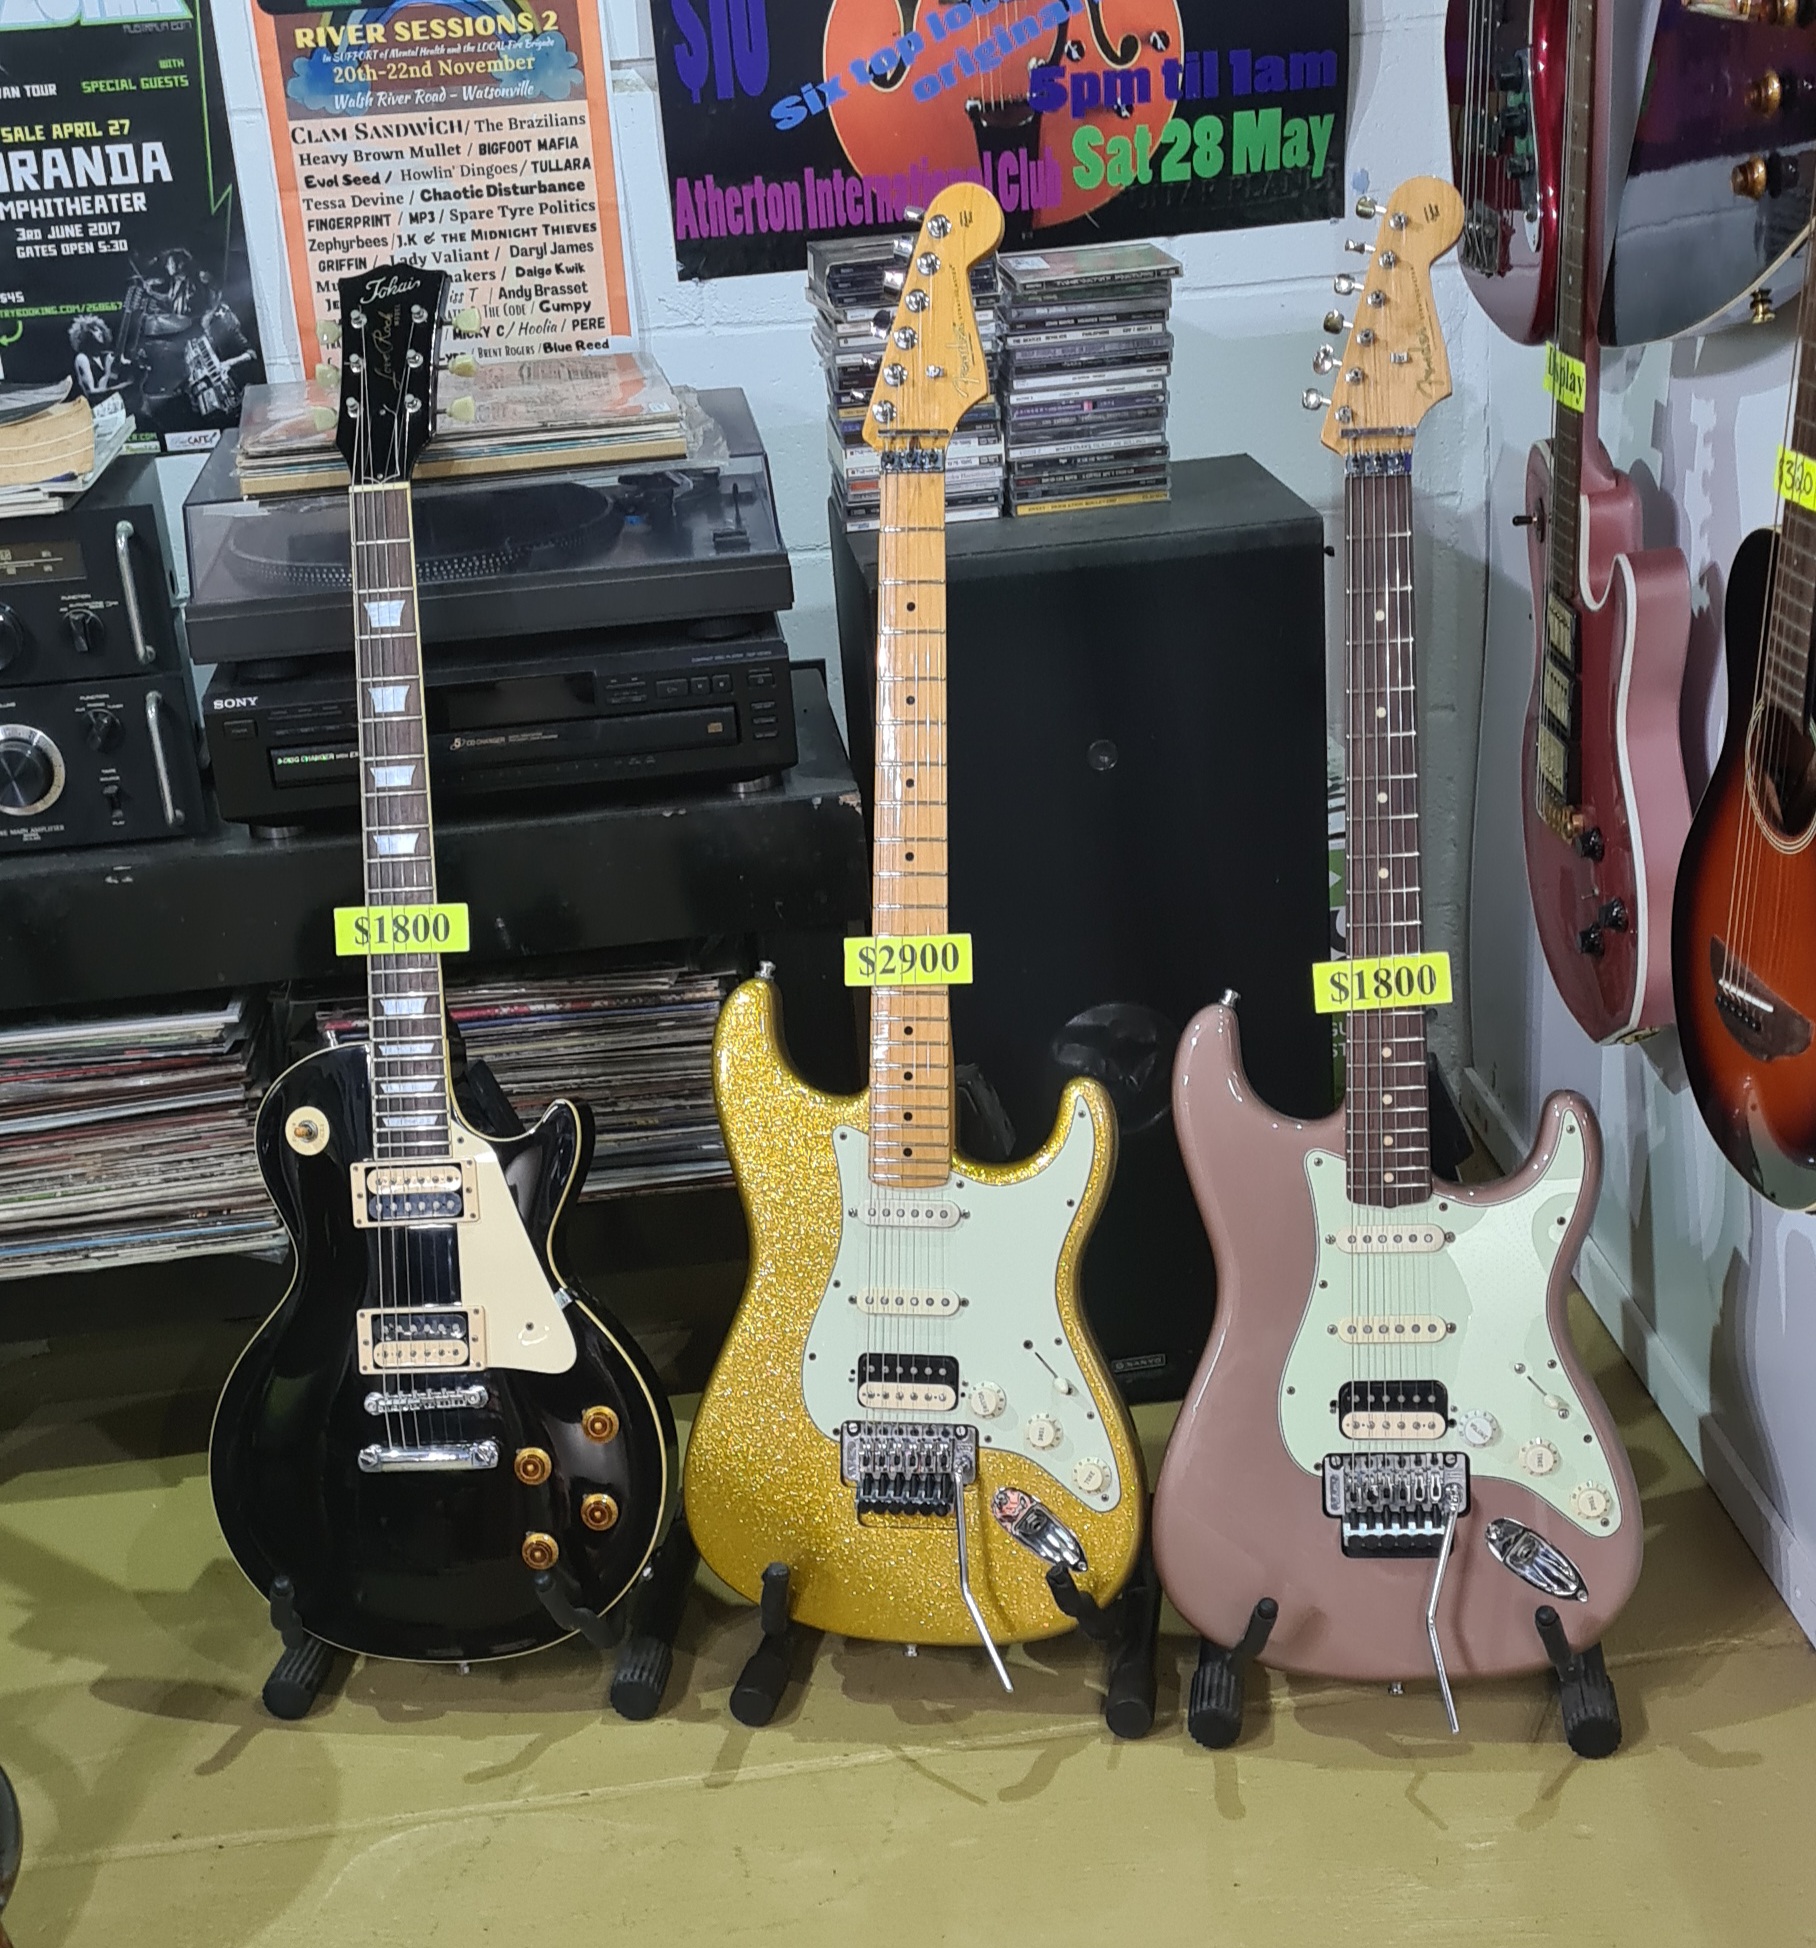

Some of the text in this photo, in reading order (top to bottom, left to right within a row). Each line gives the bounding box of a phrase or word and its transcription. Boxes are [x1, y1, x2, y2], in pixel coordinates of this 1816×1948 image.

[294, 10, 559, 48] RIVER SESSIONS 2
[159, 58, 184, 69] WITH
[333, 49, 378, 62] SUPPORT
[379, 48, 388, 60] of
[390, 46, 418, 58] Mental
[419, 45, 445, 56] Health
[446, 44, 461, 54] and
[463, 42, 475, 53] the
[525, 36, 555, 51] Brigade
[849, 30, 925, 85] top
[333, 54, 536, 83] 20th-22nd November
[1028, 49, 1337, 118] 5pm til 1am
[0, 83, 57, 99] AN TOUR
[81, 75, 189, 94] SPECIAL GUESTS
[335, 80, 534, 110] Walsh River Road Watsonville
[0, 119, 130, 143] SALE APRIL 27
[291, 126, 347, 145] CLAM
[474, 118, 503, 133] The
[508, 113, 586, 131] Brazilians
[299, 136, 579, 167] Heavy Brown Mullet BIGFOOT MAFIA
[1072, 107, 1334, 190] Sat 28 May
[304, 174, 339, 189] Evol
[342, 172, 380, 187] Seed
[400, 165, 456, 182] Howlin'
[531, 157, 591, 173] TULLARA
[302, 180, 585, 211] Tessa Devine Chaotic Disturbance
[676, 173, 803, 240] Atherton
[997, 146, 1063, 212] Club
[307, 199, 596, 232] FINGERPRINT MP3 Spare Tyre Politics
[15, 221, 121, 241] 3RD JUNE 2017
[308, 235, 389, 254] Zephyrbees
[441, 232, 467, 244] THE
[471, 227, 538, 242] MIDNIGHT
[542, 222, 597, 236] THIEVES
[16, 239, 128, 259] GATES OPEN 5:30
[318, 257, 367, 272] GRIFFIN
[431, 248, 490, 265] Valiant
[509, 242, 548, 259] Daryl
[550, 241, 594, 255] James
[555, 263, 586, 275] Kwik
[360, 275, 421, 304] Tokai
[499, 284, 532, 302] Andy
[534, 281, 588, 298] Brasset
[539, 300, 591, 314] Gumpy
[518, 318, 557, 336] Hoolia
[571, 317, 605, 331] PERE
[478, 347, 502, 359] BRENT
[505, 345, 535, 356] ROGERS
[576, 339, 609, 352] Reed
[213, 696, 258, 710] SONY
[354, 913, 450, 946] $1800
[858, 942, 959, 978] $2900
[1329, 964, 1437, 1004] $1800
